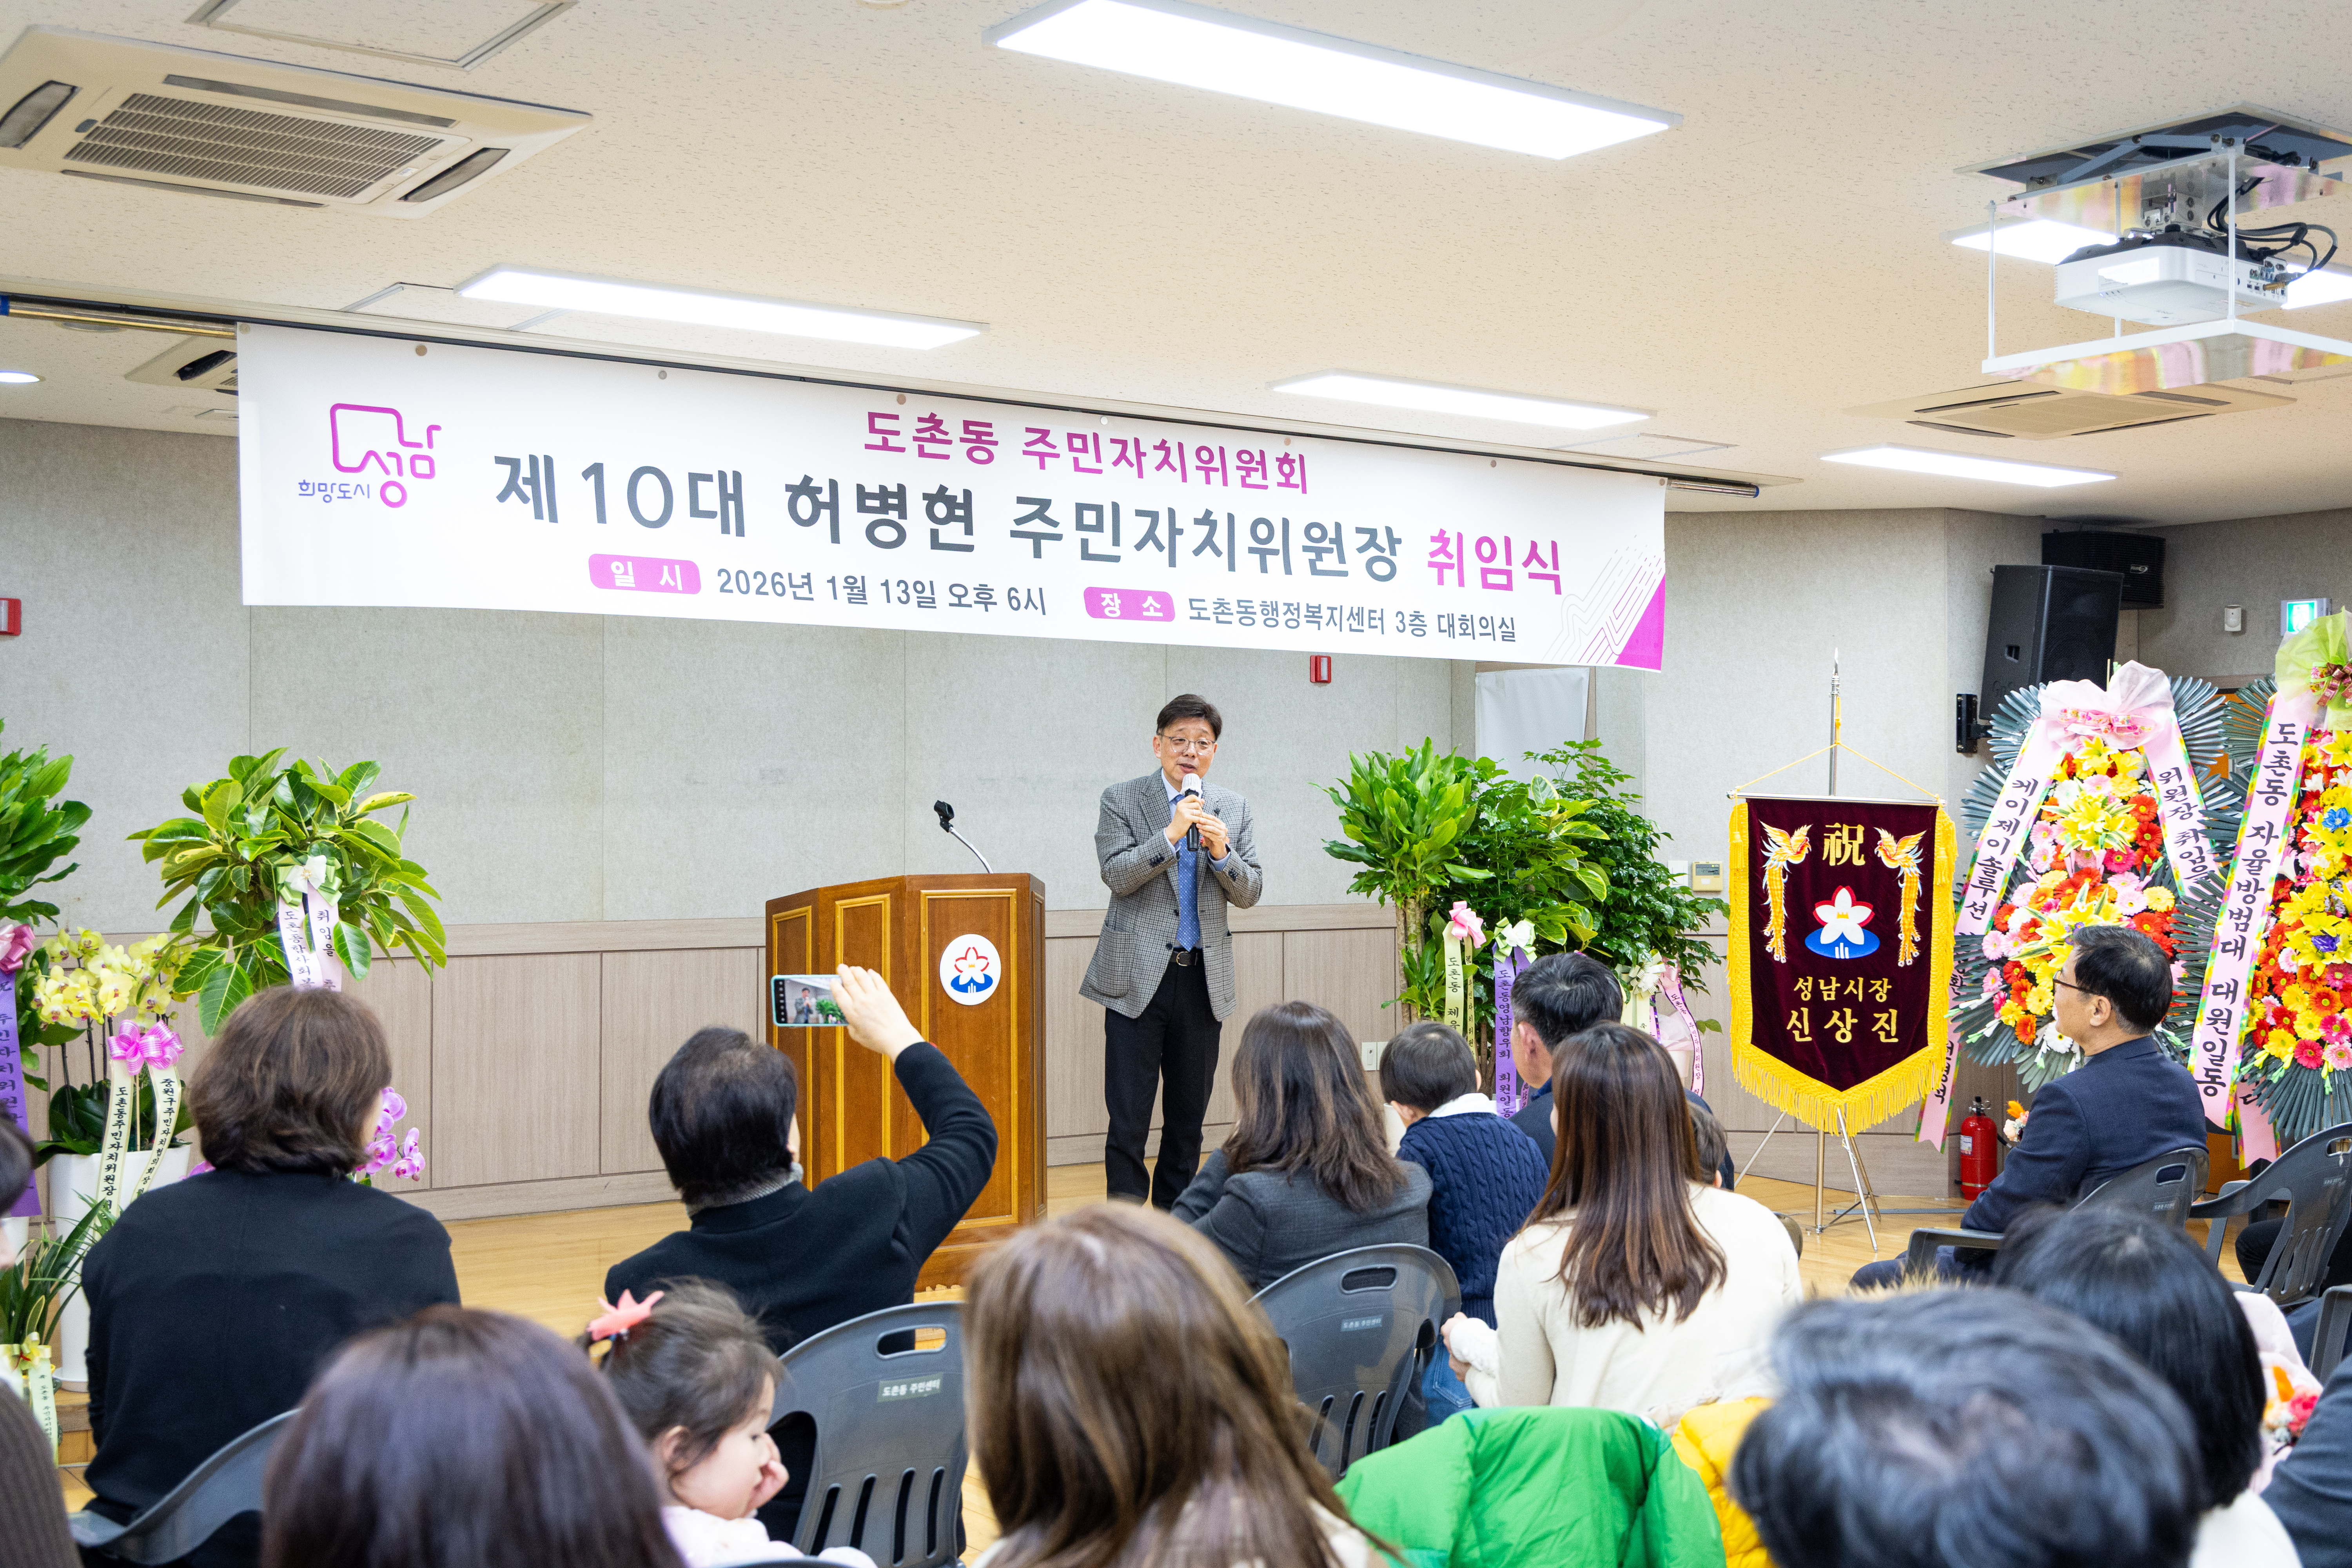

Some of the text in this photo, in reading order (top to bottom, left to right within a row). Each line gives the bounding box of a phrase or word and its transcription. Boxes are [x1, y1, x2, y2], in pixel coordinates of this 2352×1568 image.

[864, 411, 1308, 494] 도촌동 주민자치위원회
[298, 479, 370, 503] 희망도시
[494, 454, 1562, 595] 제10대 허병현 주민자치위원장 취임식
[717, 568, 814, 601] 2026년
[827, 575, 868, 605] 1월
[880, 579, 937, 609] 13일
[949, 583, 997, 612] 오후
[1007, 587, 1046, 615] 6시
[1188, 598, 1384, 635] 도촌동행정복지센터
[1396, 610, 1427, 637] 3층
[1437, 613, 1516, 642] 대회의실
[2158, 767, 2198, 820] 위원장
[1823, 822, 1866, 866] 祝
[1964, 778, 2039, 921] 케이제이솔루션
[317, 909, 336, 957] 취임을
[2195, 723, 2298, 1097] 도촌동 자율방범대 대원일동
[1448, 957, 1461, 993] 도촌동
[1794, 976, 1892, 1002] 성남시장
[1498, 969, 1514, 1118] 도촌동영남향우회 회원일동
[102, 1087, 128, 1196] 도촌동주민자치위원장
[882, 1379, 940, 1397] 도촌동 주민센터
